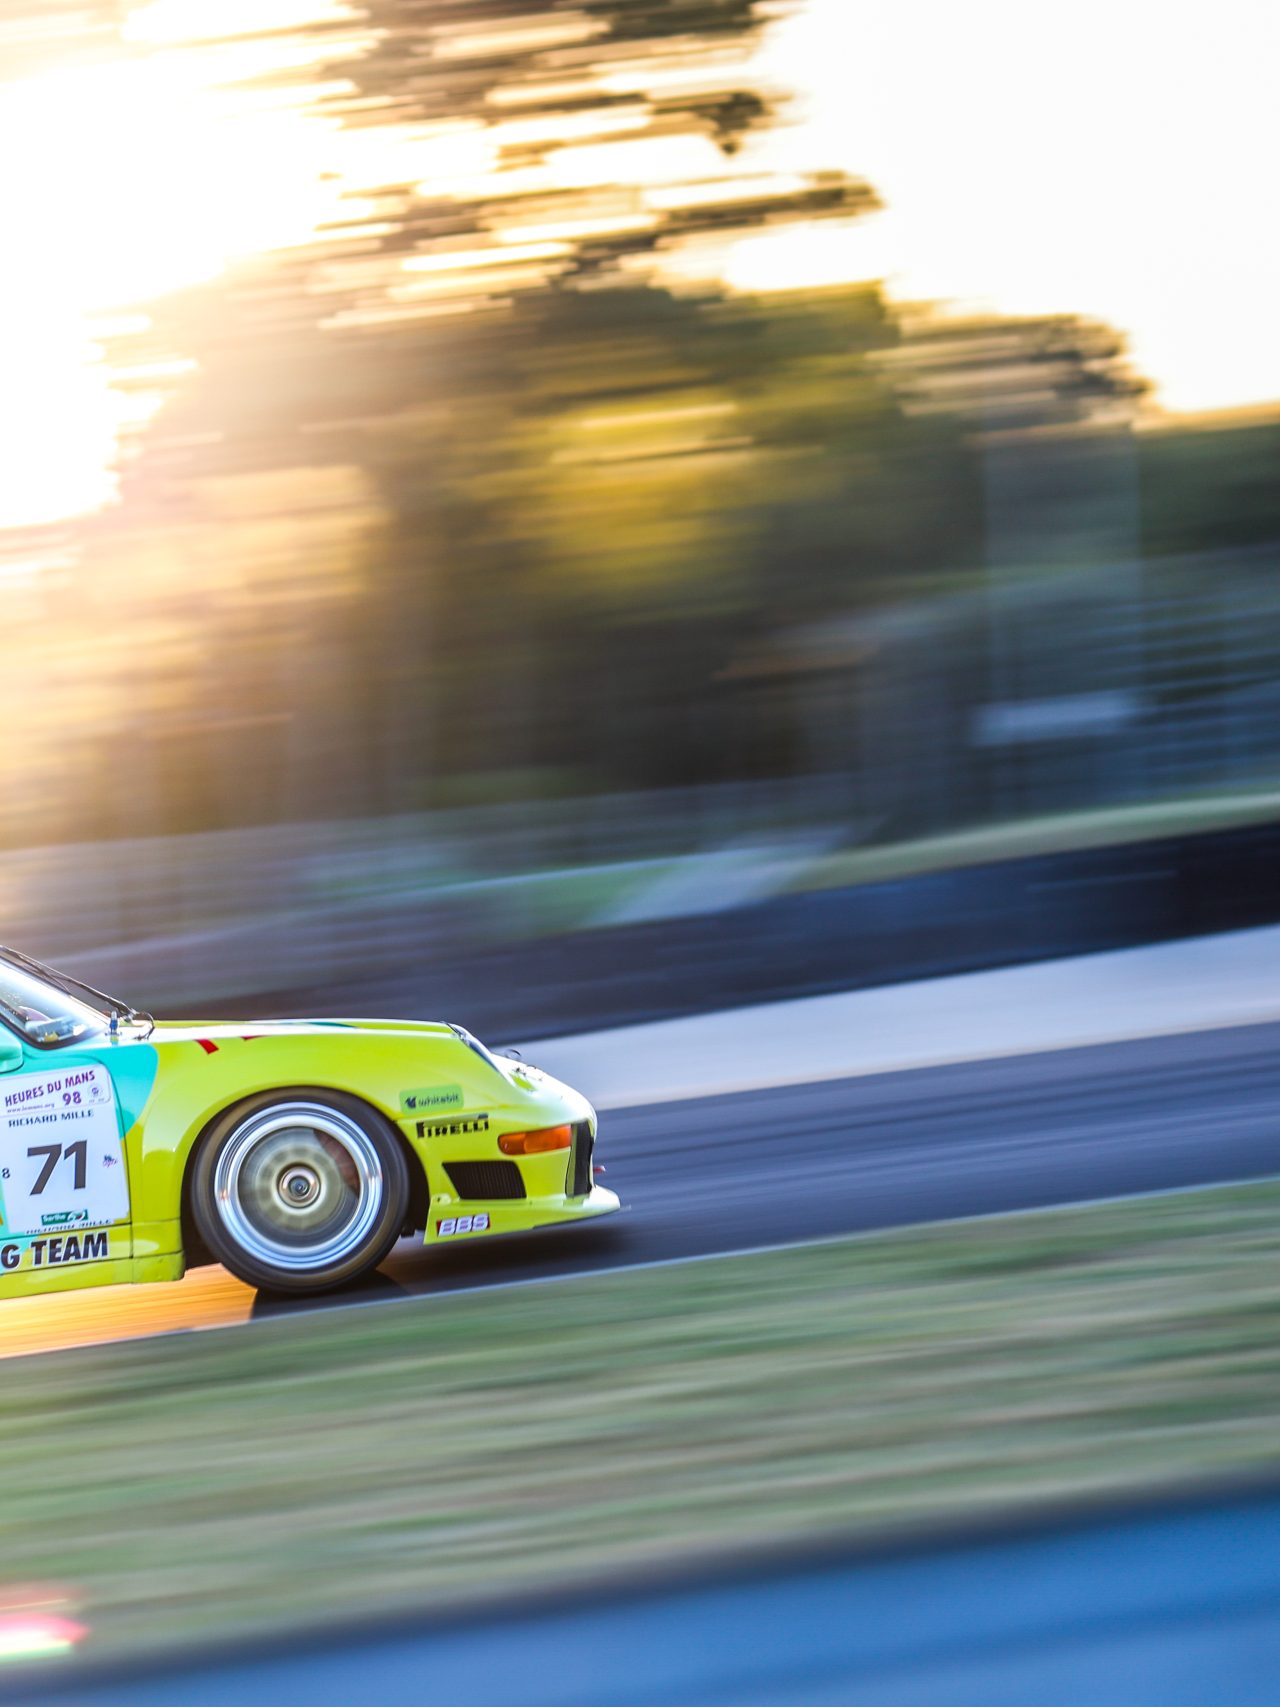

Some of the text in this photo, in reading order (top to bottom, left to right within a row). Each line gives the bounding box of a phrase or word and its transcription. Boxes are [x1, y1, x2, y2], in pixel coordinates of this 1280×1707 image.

[5, 1070, 95, 1107] HEURES DU MANS
[62, 1091, 82, 1106] 98
[8, 1109, 94, 1128] RICHARD MILLE
[416, 1113, 489, 1139] PIRELLI
[2, 1167, 11, 1180] 8
[27, 1140, 88, 1196] 71
[438, 1213, 489, 1236] BBS
[31, 1231, 108, 1264] TEAM
